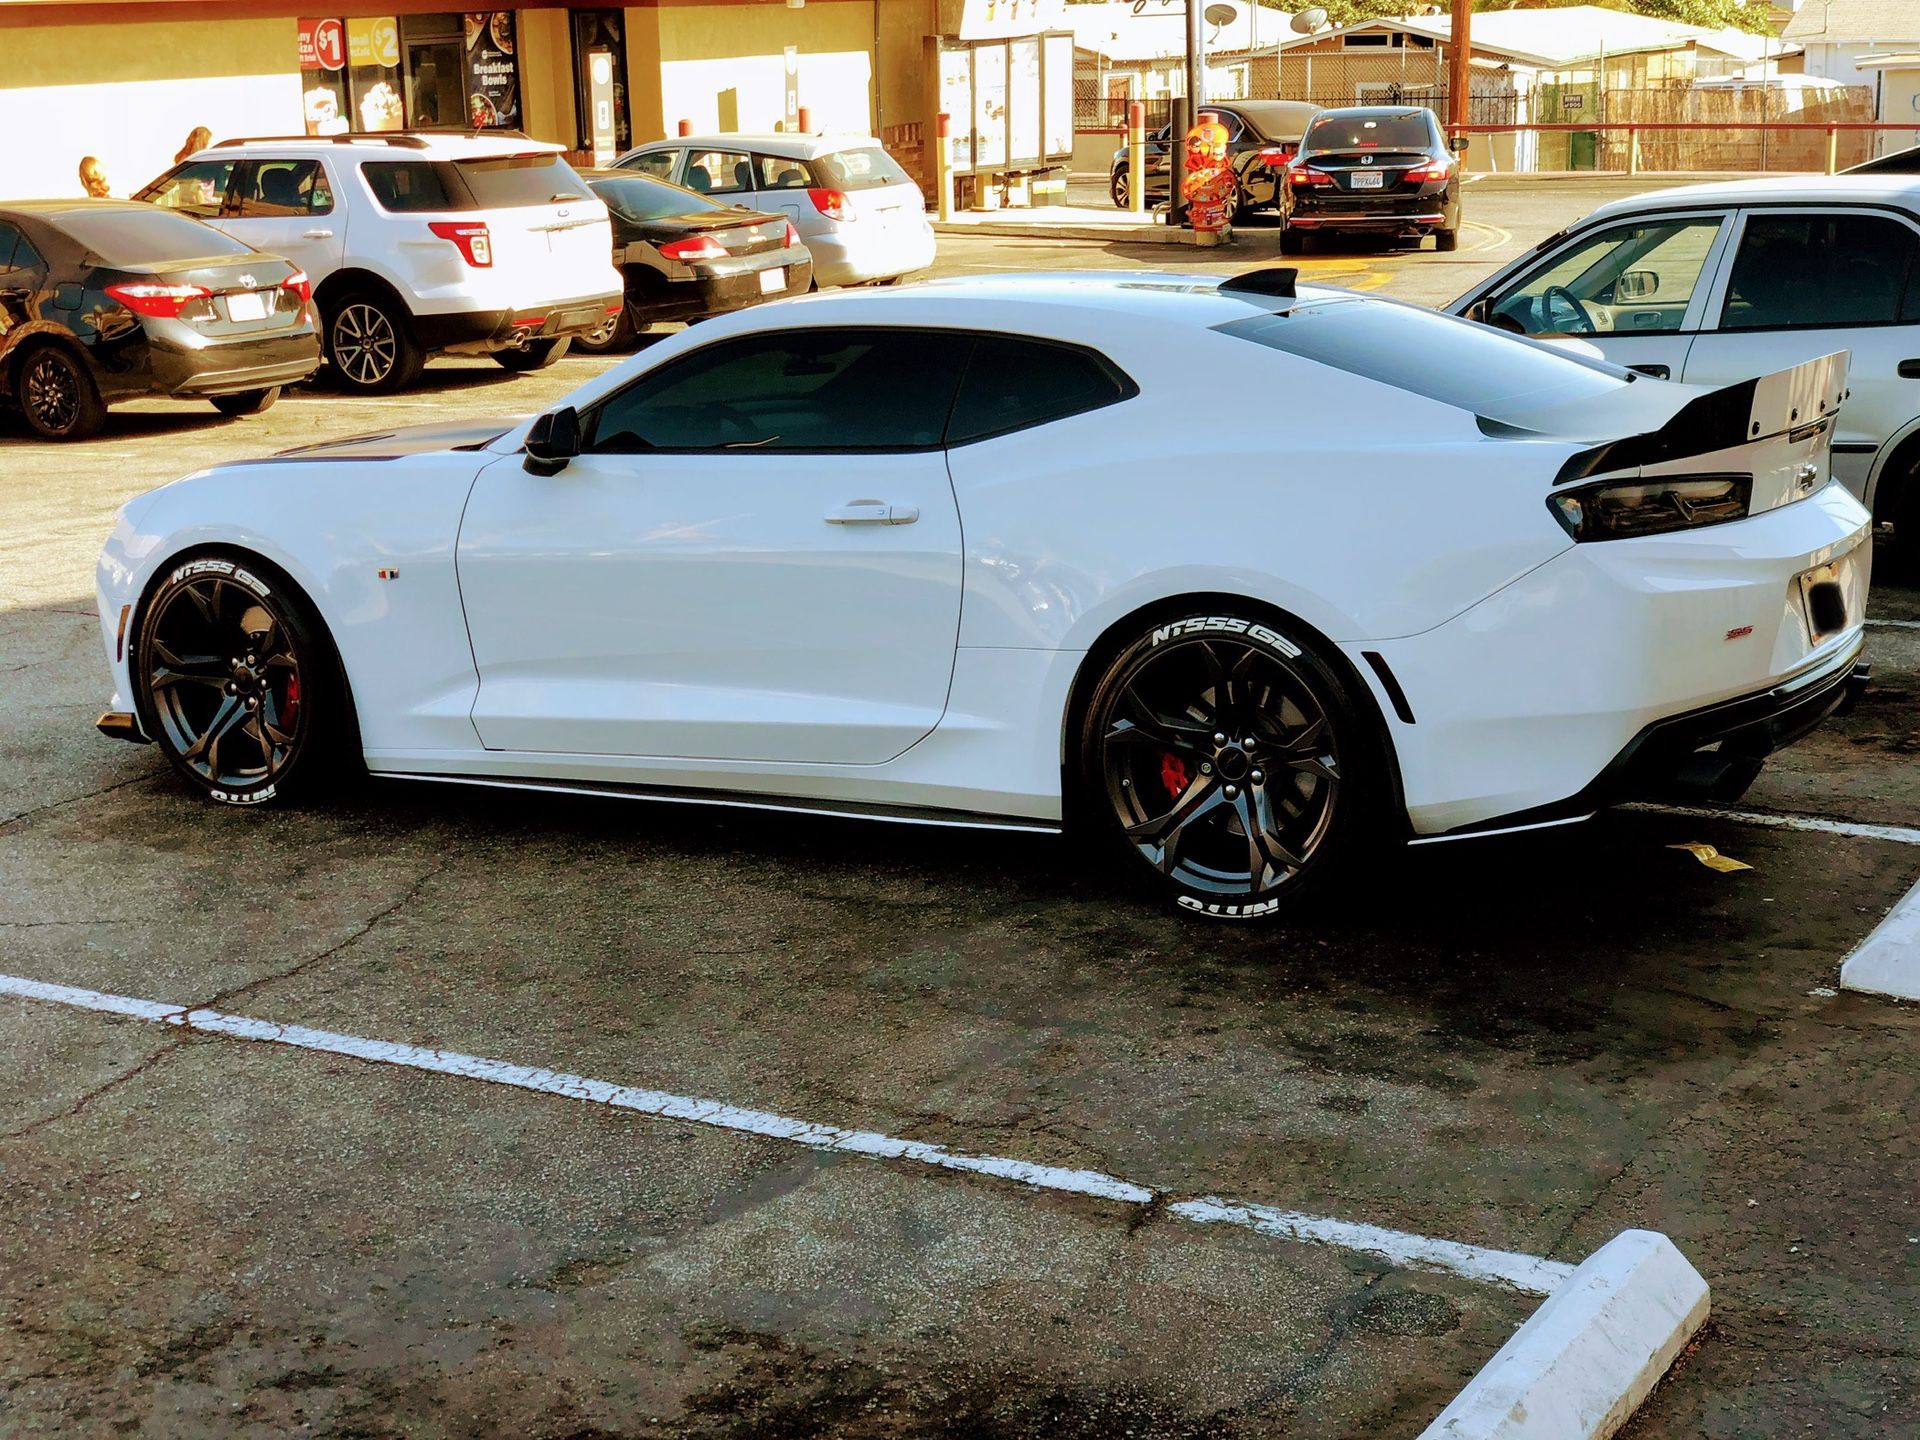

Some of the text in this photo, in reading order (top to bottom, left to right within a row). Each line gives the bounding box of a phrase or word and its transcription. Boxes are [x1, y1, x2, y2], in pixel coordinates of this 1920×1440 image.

[319, 28, 340, 60] $1
[375, 27, 399, 57] $2
[473, 62, 514, 74] Breakfast
[482, 74, 507, 86] Bowls
[1152, 616, 1251, 647] NT555
